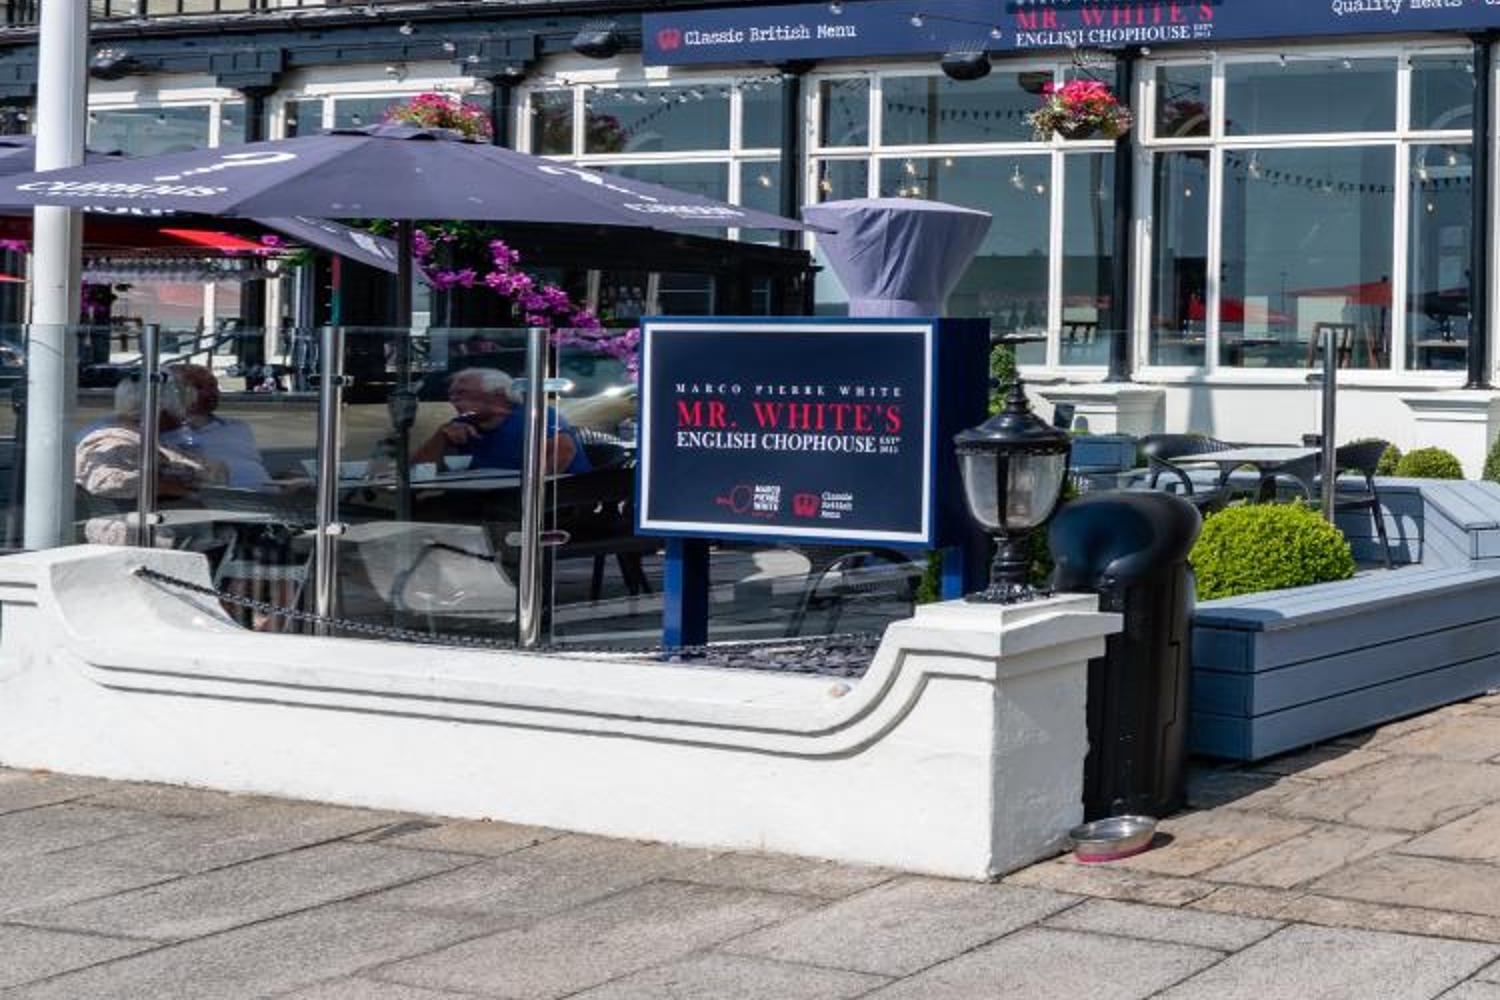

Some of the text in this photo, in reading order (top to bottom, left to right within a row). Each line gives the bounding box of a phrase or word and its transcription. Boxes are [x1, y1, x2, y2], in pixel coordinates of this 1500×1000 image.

[684, 23, 858, 46] Classic British Menu
[1015, 27, 1084, 48] ENGLISH
[1088, 24, 1191, 44] CHOPHOUSE
[675, 383, 902, 397] MARCO PIERRE WHITE
[677, 400, 903, 433] MR. WHITE'S
[676, 430, 877, 454] ENGLISH CHOPHOUSE
